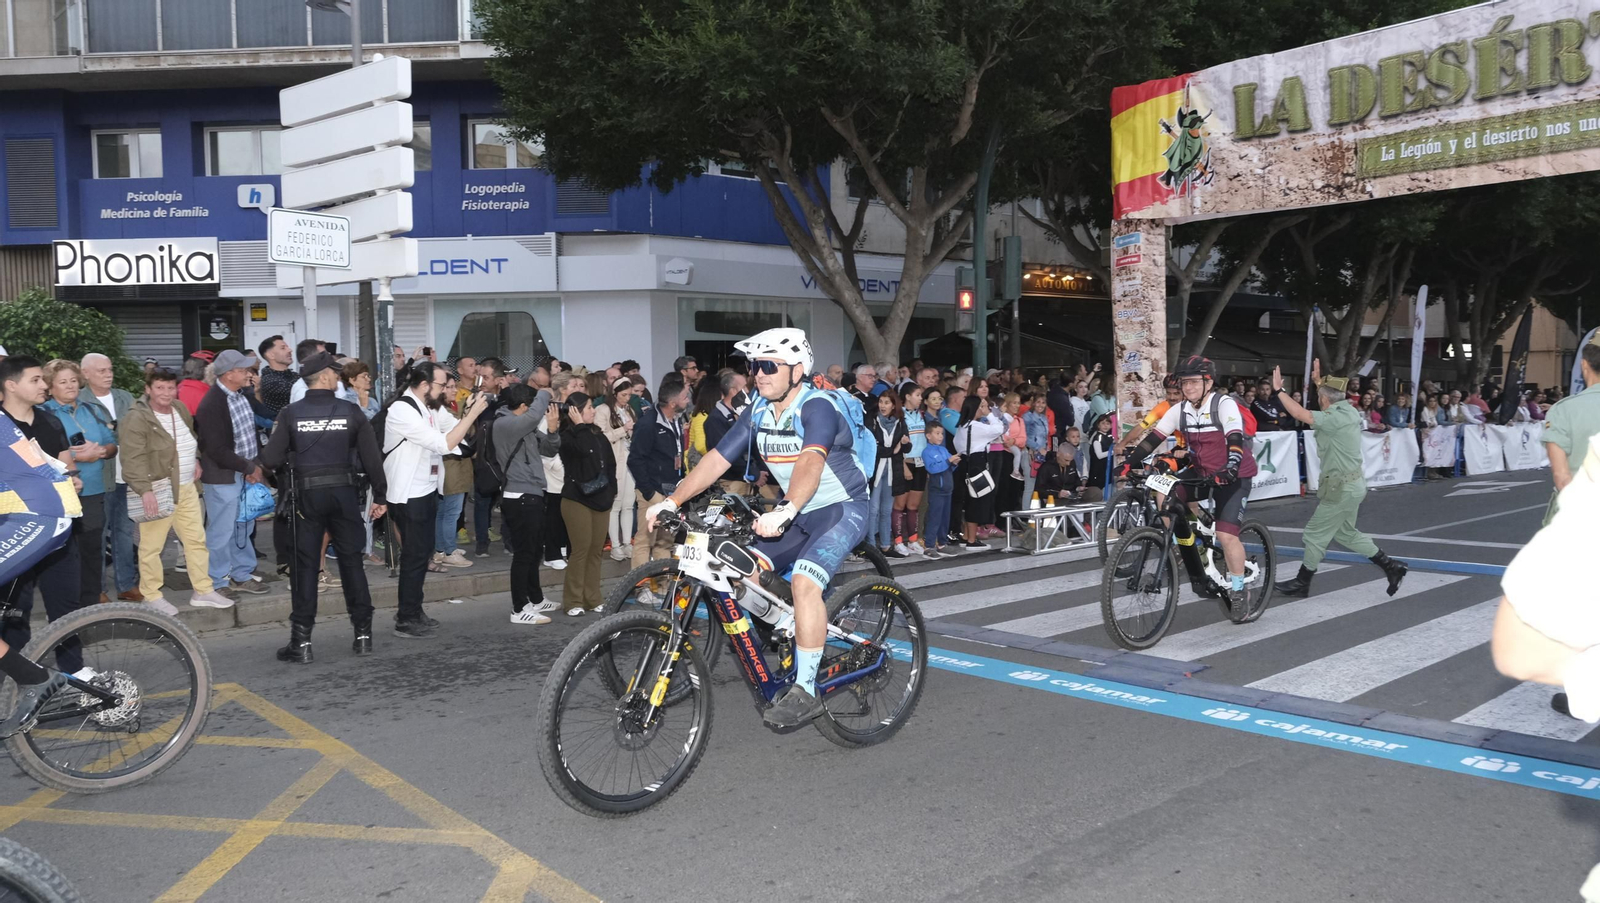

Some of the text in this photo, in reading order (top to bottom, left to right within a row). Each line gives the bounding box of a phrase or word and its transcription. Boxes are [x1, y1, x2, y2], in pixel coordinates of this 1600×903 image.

[1232, 76, 1312, 140] LA
[1381, 117, 1600, 162] La Legión y el desierto nos un
[126, 190, 183, 204] Psicología
[464, 182, 526, 196] Logopedia
[100, 206, 209, 219] Medicina de Familia
[461, 199, 530, 212] Fisioterapia
[294, 218, 346, 232] AVENIDA
[287, 231, 334, 247] FEDERICO
[275, 244, 345, 263] GARCÍA LORCA
[54, 241, 215, 284] Phonika
[297, 420, 339, 428] POLICA
[798, 563, 807, 572] LA
[871, 585, 901, 596] MAXXIS
[724, 598, 769, 683] MODRAKER
[1049, 679, 1168, 704] cajamar
[1254, 718, 1409, 750] cajamar
[1531, 770, 1600, 790] caj
